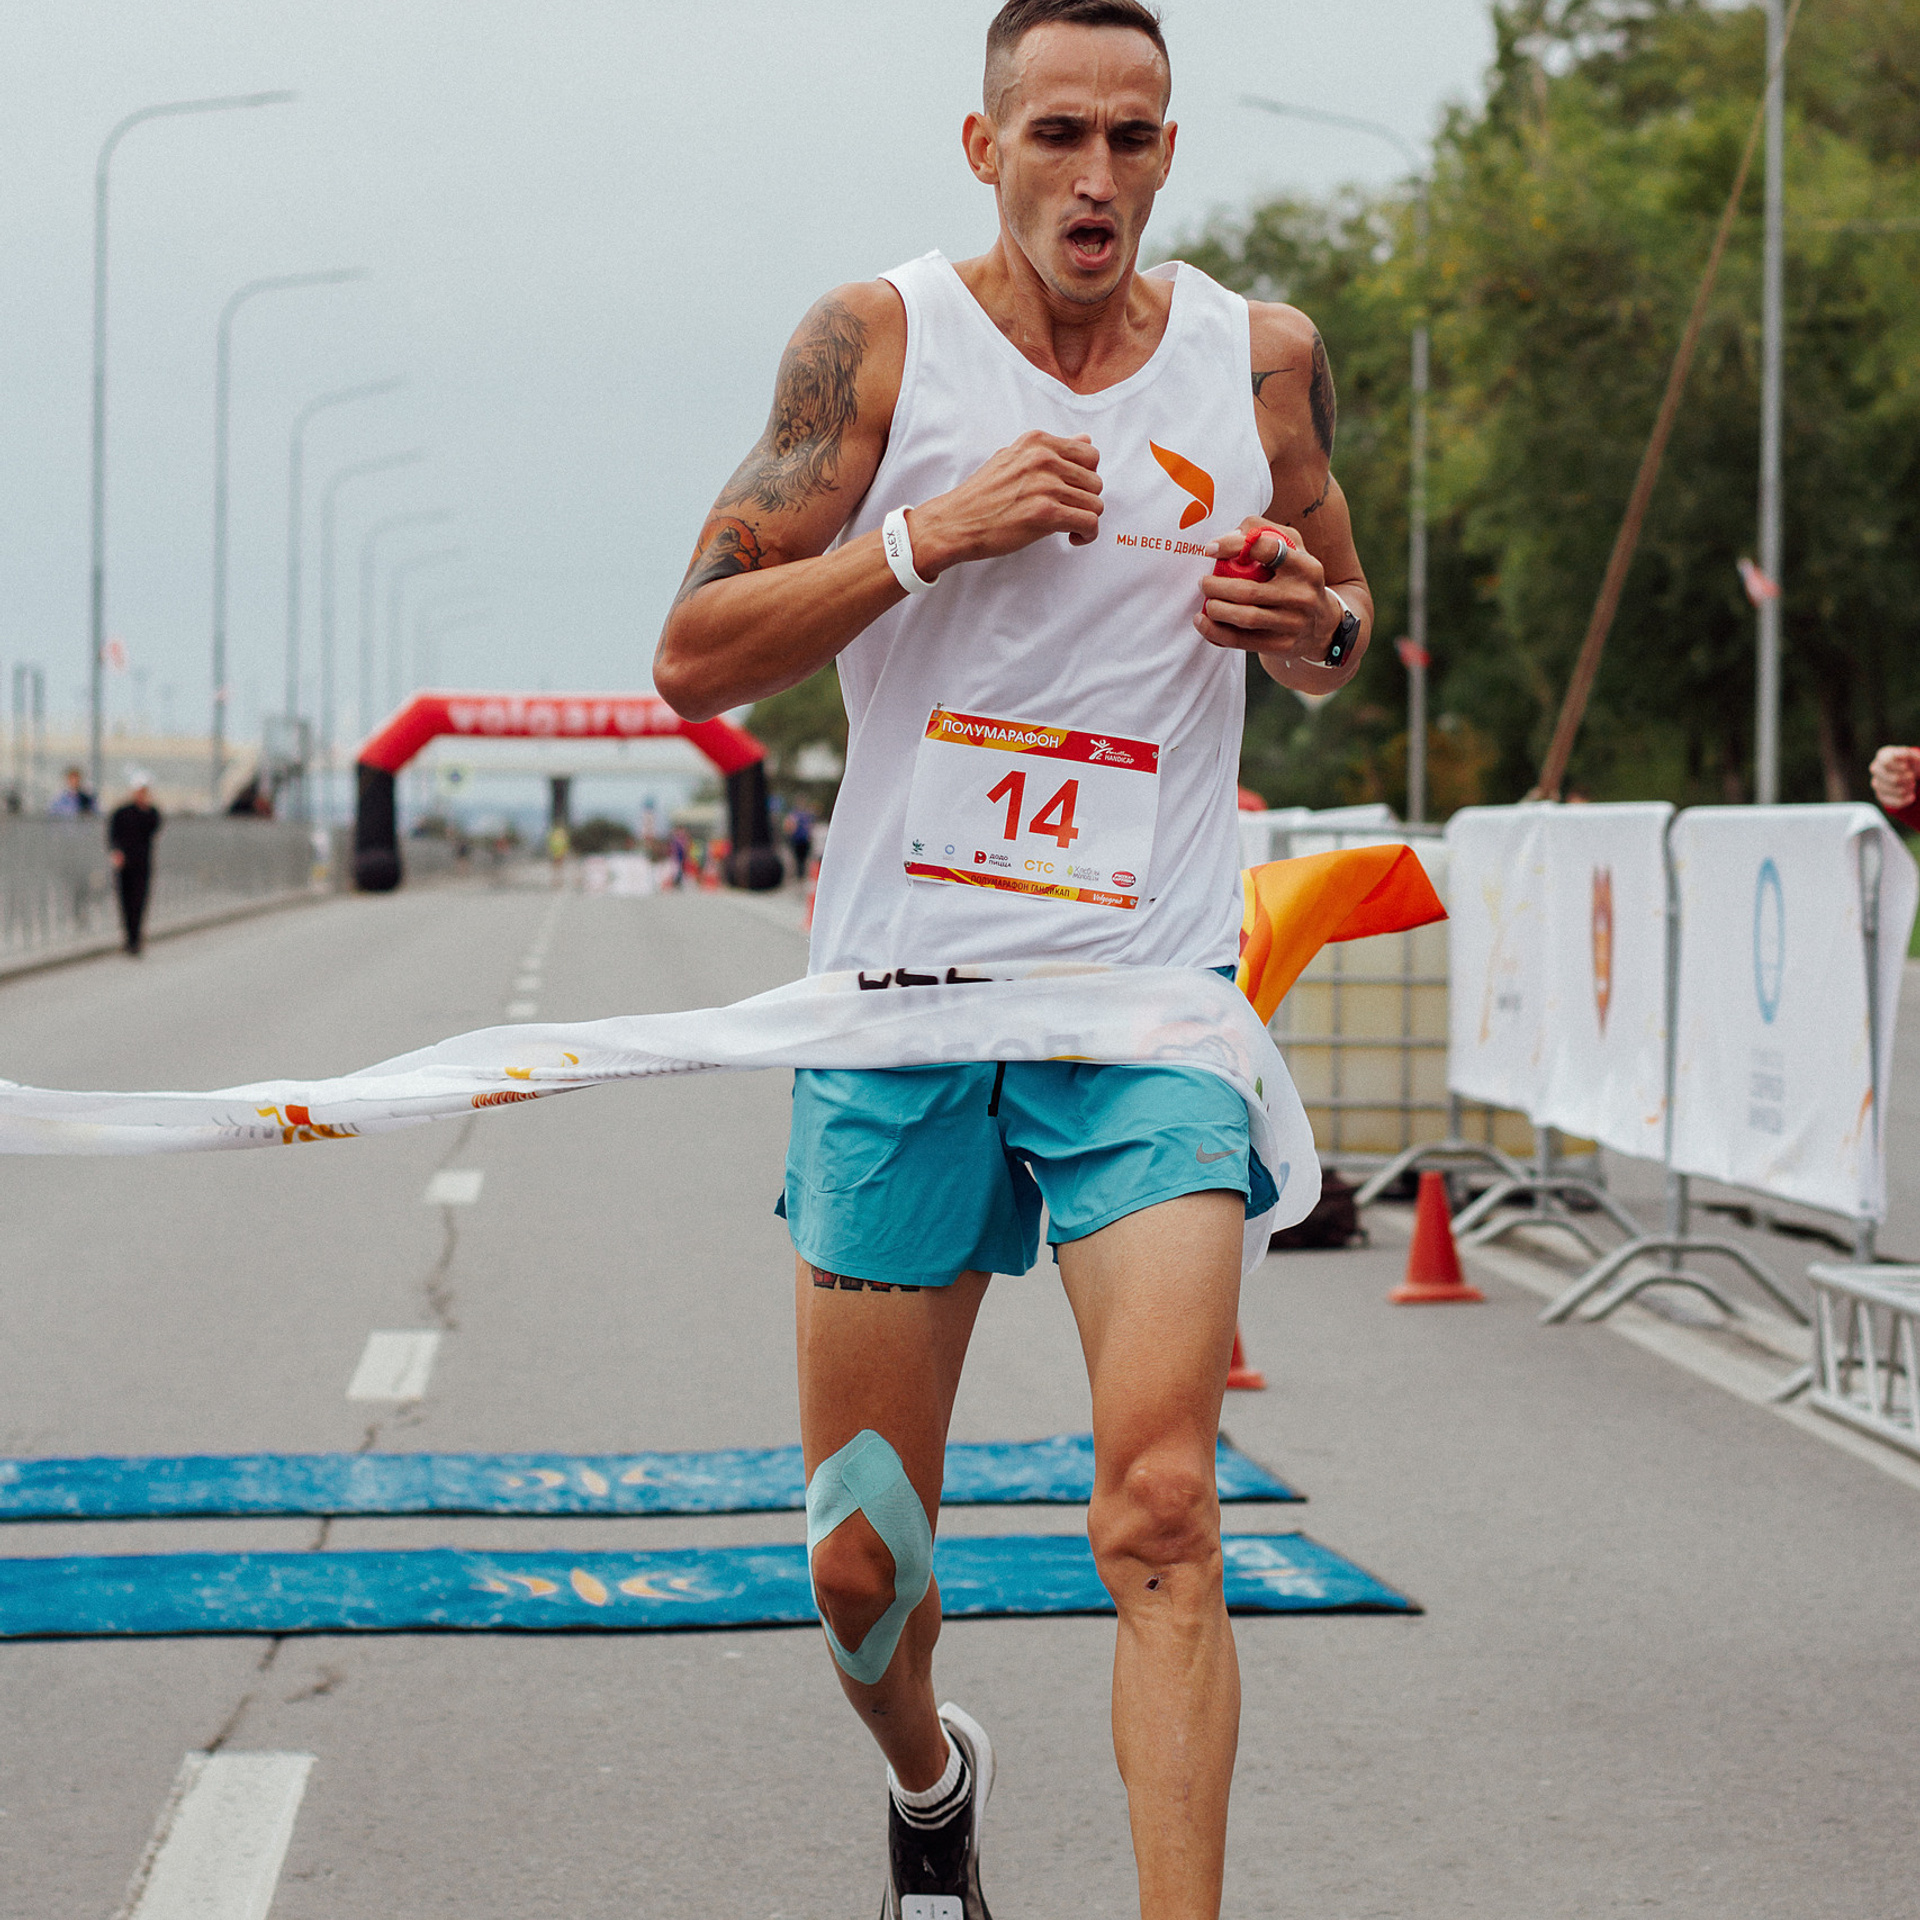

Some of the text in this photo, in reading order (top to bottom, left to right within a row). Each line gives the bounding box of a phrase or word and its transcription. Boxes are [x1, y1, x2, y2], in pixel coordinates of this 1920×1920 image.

[887, 530, 900, 558] ALEX
[1116, 533, 1211, 557] МЫ ВСЕ В ДВИЖ
[942, 719, 1060, 749] ПОЛУМАРАФОН
[986, 770, 1080, 849] 14
[1024, 859, 1055, 874] СТС
[970, 874, 1071, 898] ПОЛУМАРАФОН ГАНДИКАП
[1092, 893, 1124, 906] Volgograd
